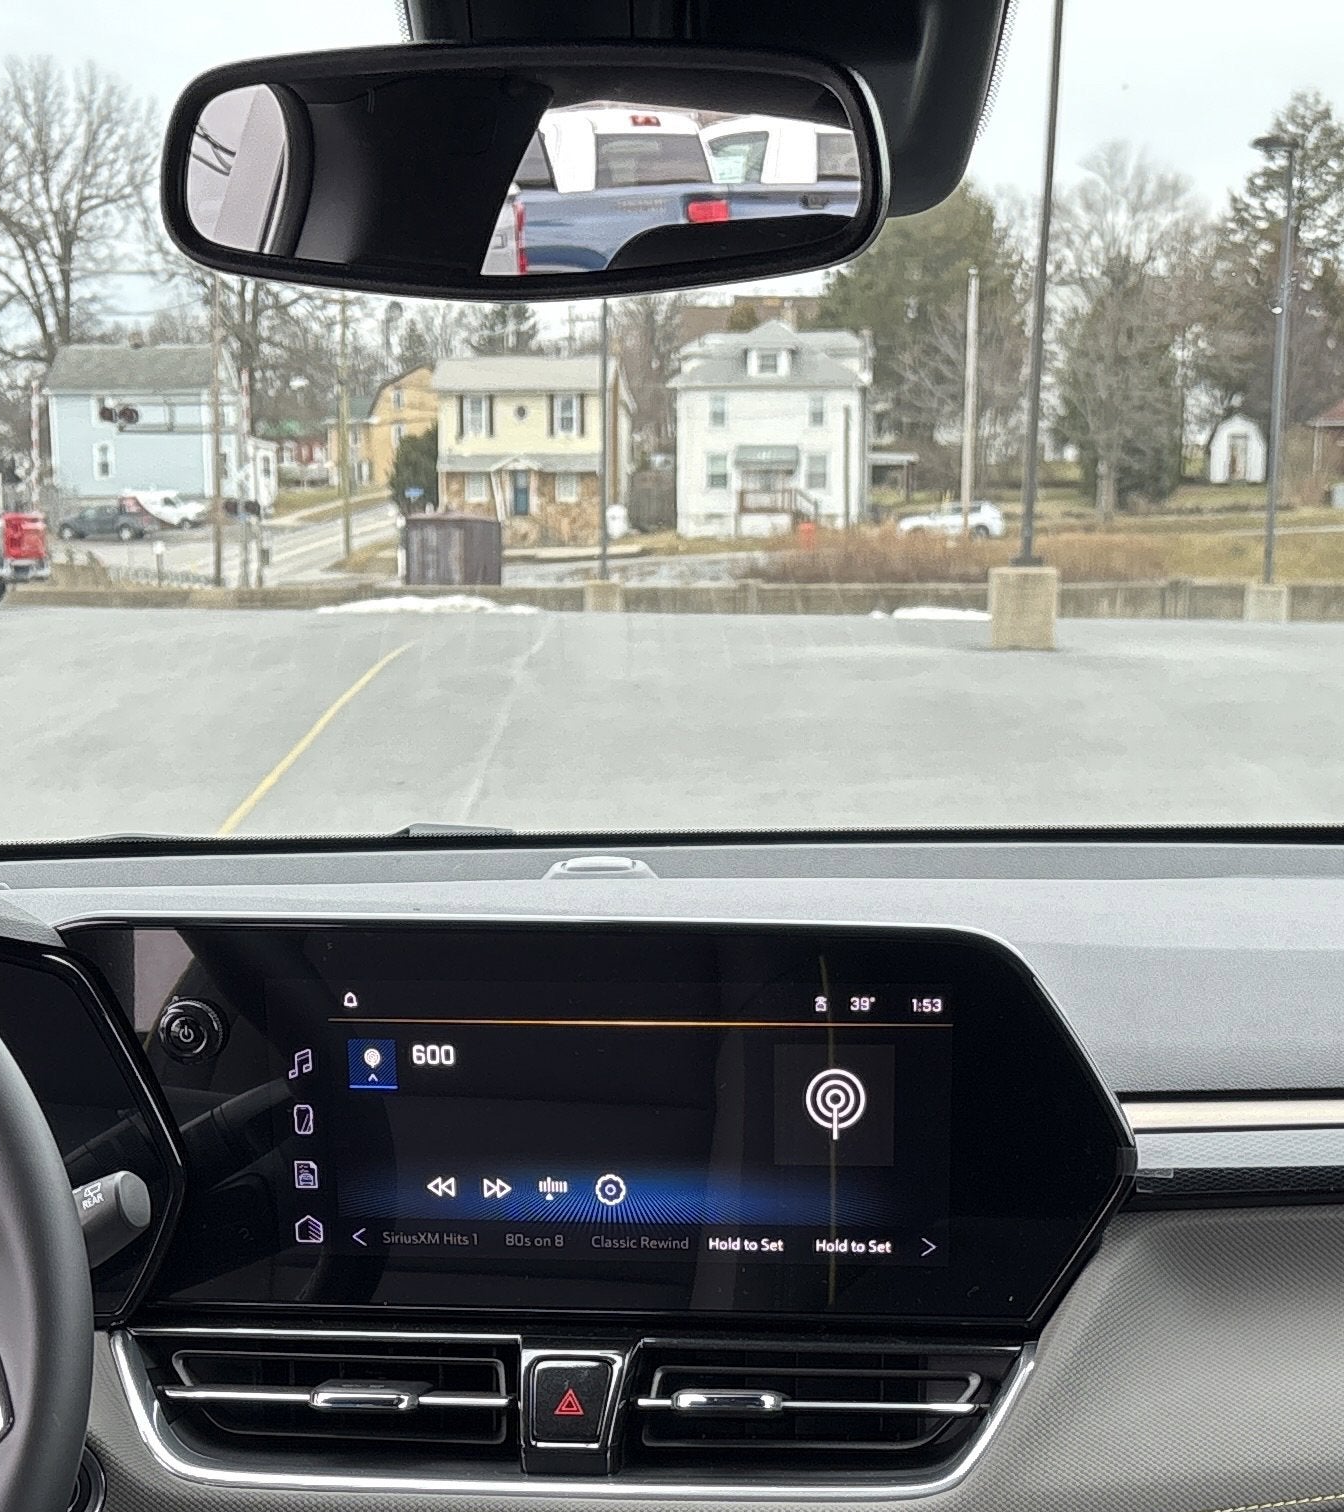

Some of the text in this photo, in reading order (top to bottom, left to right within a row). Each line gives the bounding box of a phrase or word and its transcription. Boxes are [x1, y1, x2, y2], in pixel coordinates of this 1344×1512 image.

[911, 998, 943, 1013] 1:53
[411, 1044, 455, 1067] 600
[82, 1191, 105, 1210] REAR
[381, 1230, 479, 1247] SiriusXM Hits 1
[504, 1233, 565, 1248] 80s on 8
[590, 1234, 690, 1251] Classic Rewind
[707, 1236, 784, 1253] Hold to Set
[814, 1238, 892, 1254] Hold to Set
